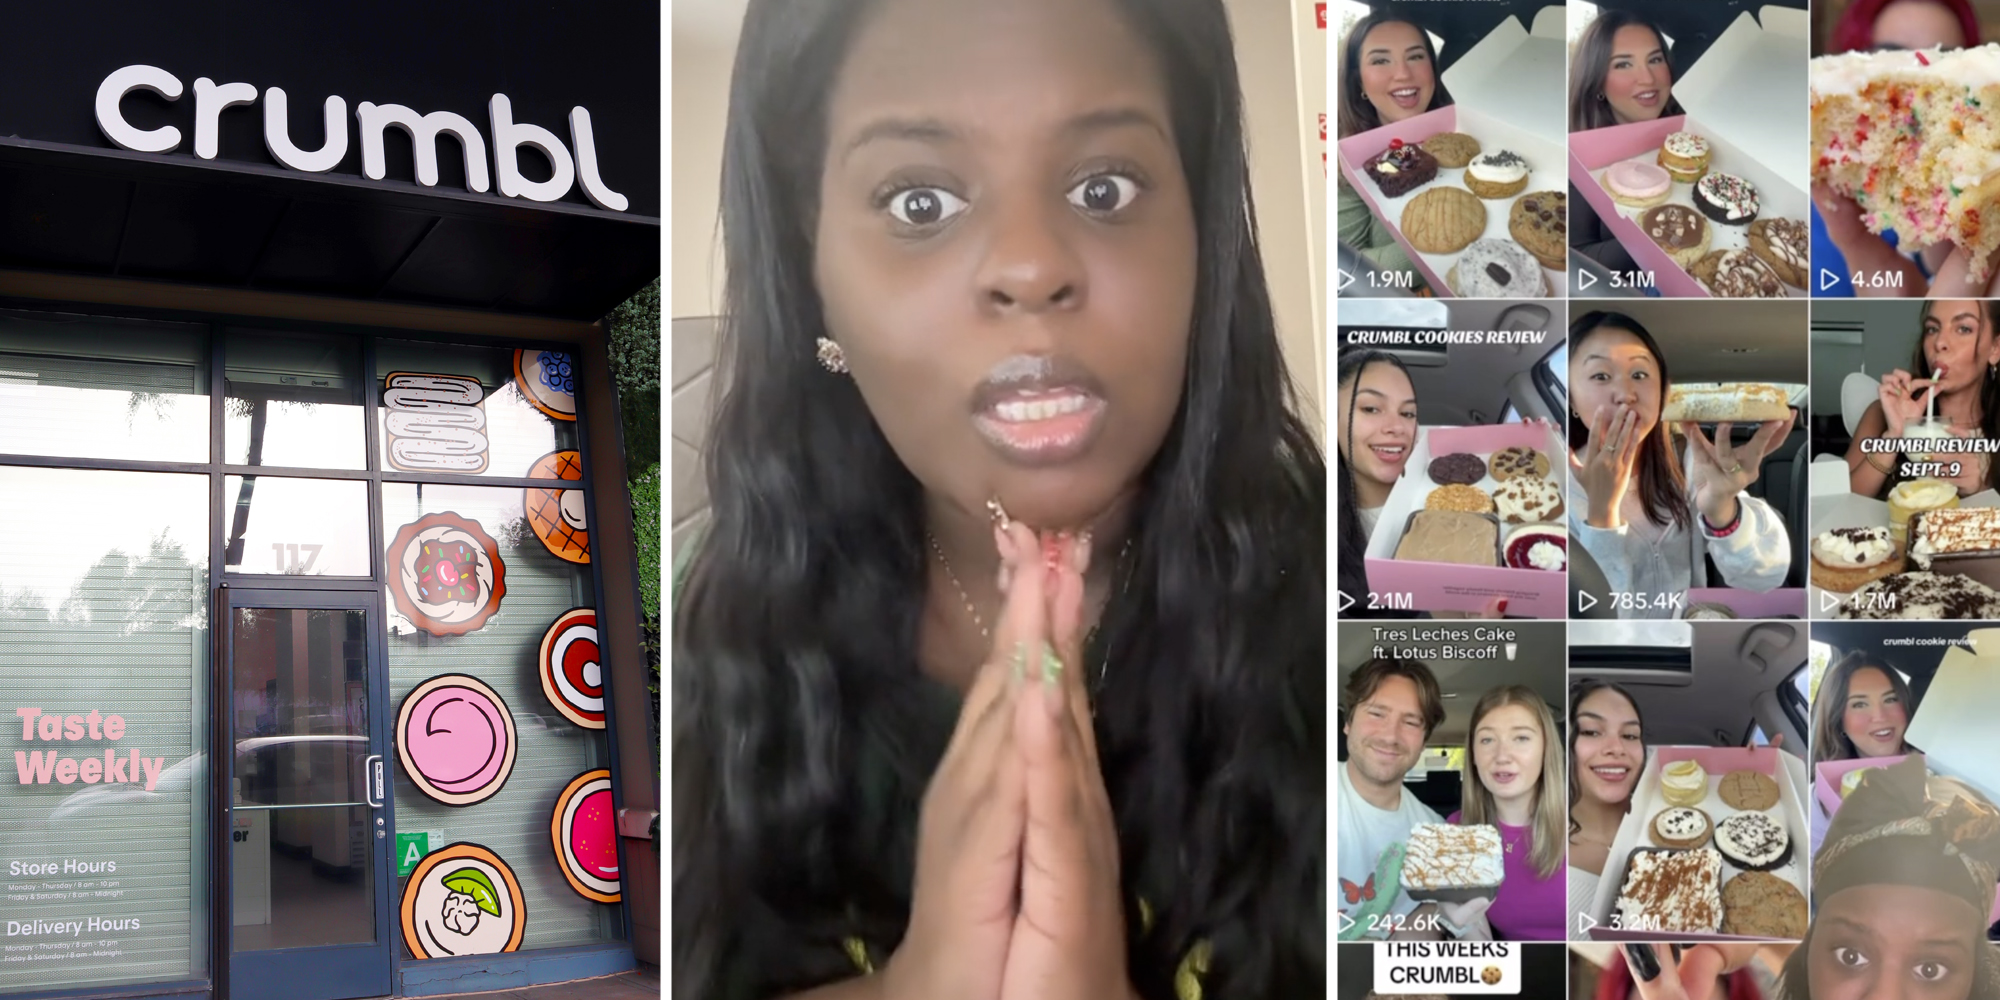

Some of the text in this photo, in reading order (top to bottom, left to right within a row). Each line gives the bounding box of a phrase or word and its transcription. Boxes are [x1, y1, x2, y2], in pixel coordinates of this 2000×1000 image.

[95, 63, 629, 212] crumbl
[271, 543, 324, 573] 117
[16, 707, 126, 741] Taste
[14, 748, 165, 791] Weekly
[403, 841, 421, 867] A
[9, 859, 117, 876] Store Hours
[36, 891, 67, 900] Saturday
[95, 890, 124, 898] Midnight
[41, 882, 73, 890] Thursday
[7, 917, 141, 937] Delivery Hours
[4, 955, 26, 963] Friday
[33, 951, 65, 960] Saturday
[93, 949, 122, 957] Midnight
[39, 942, 71, 950] Thursday
